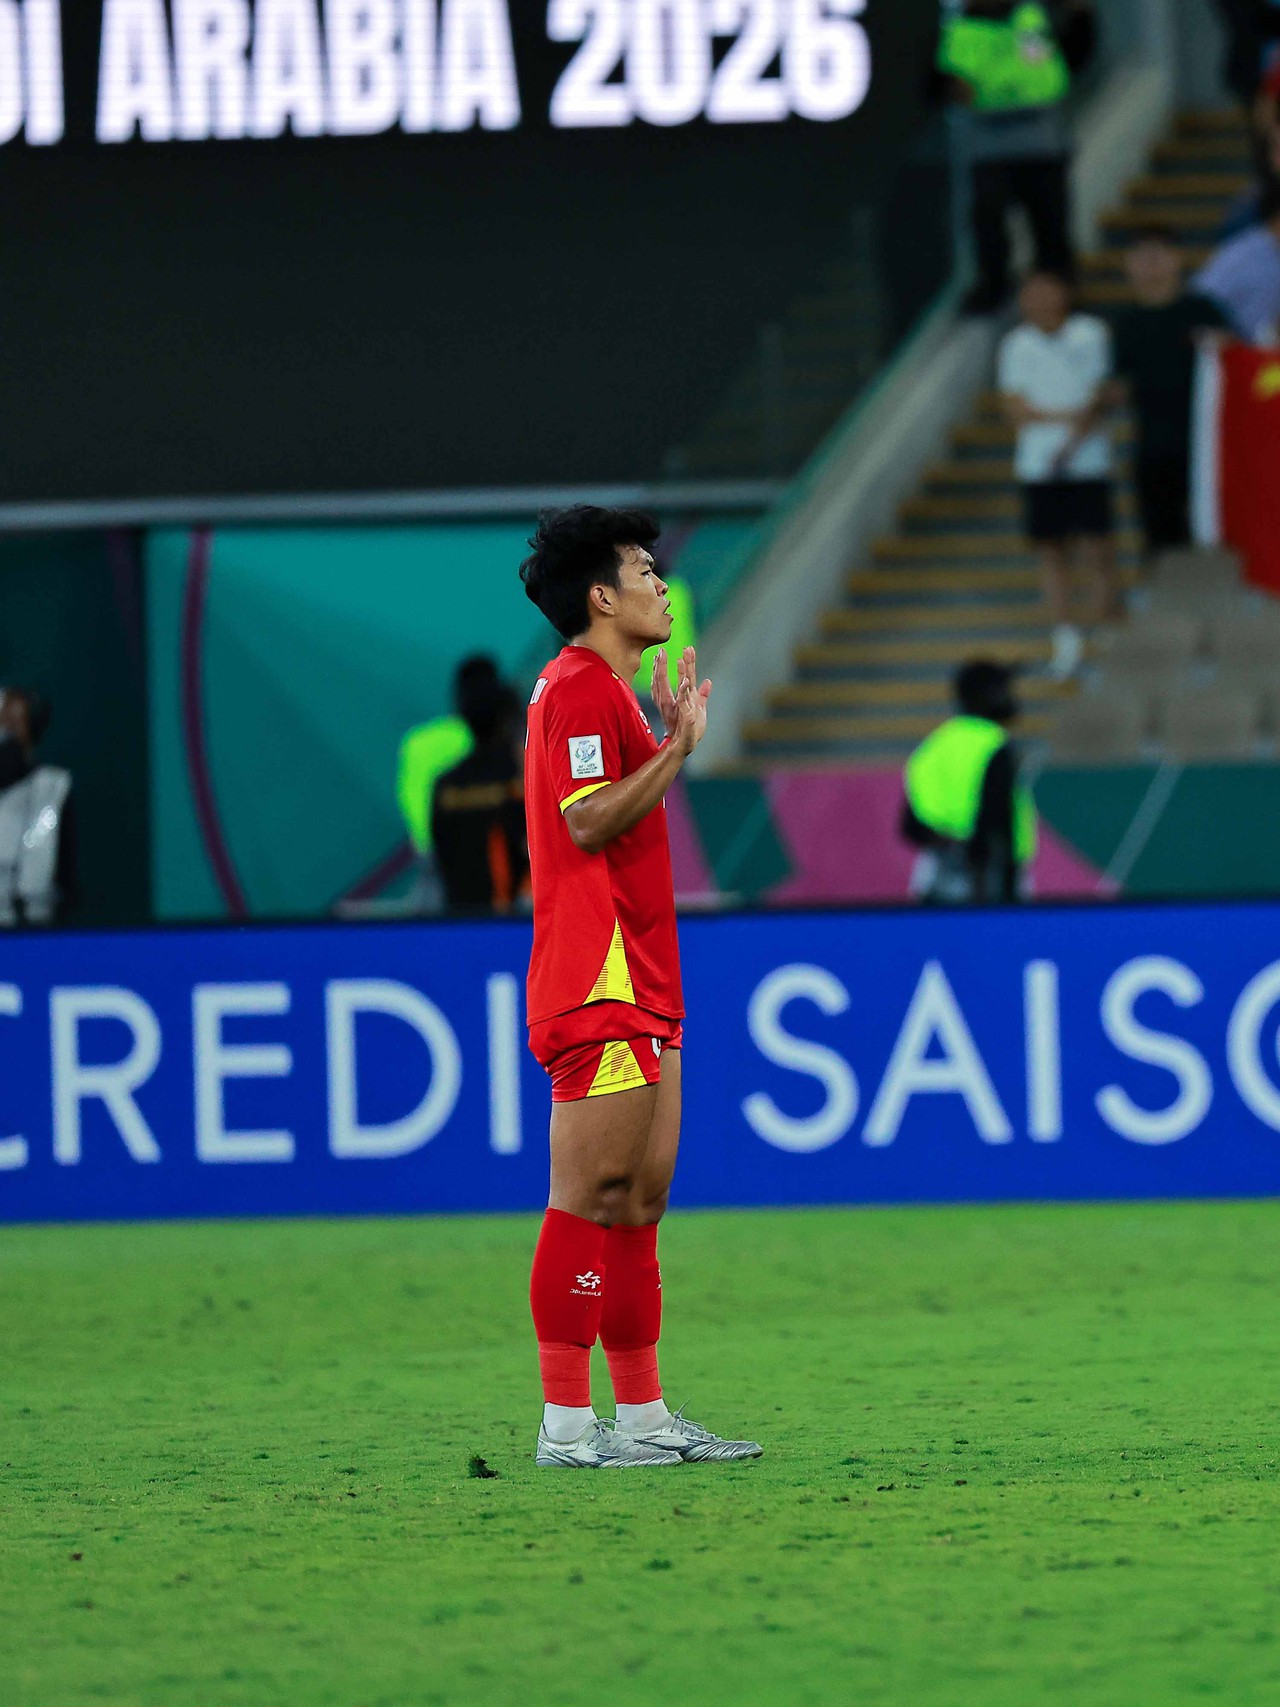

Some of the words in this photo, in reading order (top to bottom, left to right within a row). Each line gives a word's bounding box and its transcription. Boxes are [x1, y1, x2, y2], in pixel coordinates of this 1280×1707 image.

[95, 0, 521, 144] ARABIA
[546, 0, 871, 128] 2026
[0, 973, 523, 1170] REDI
